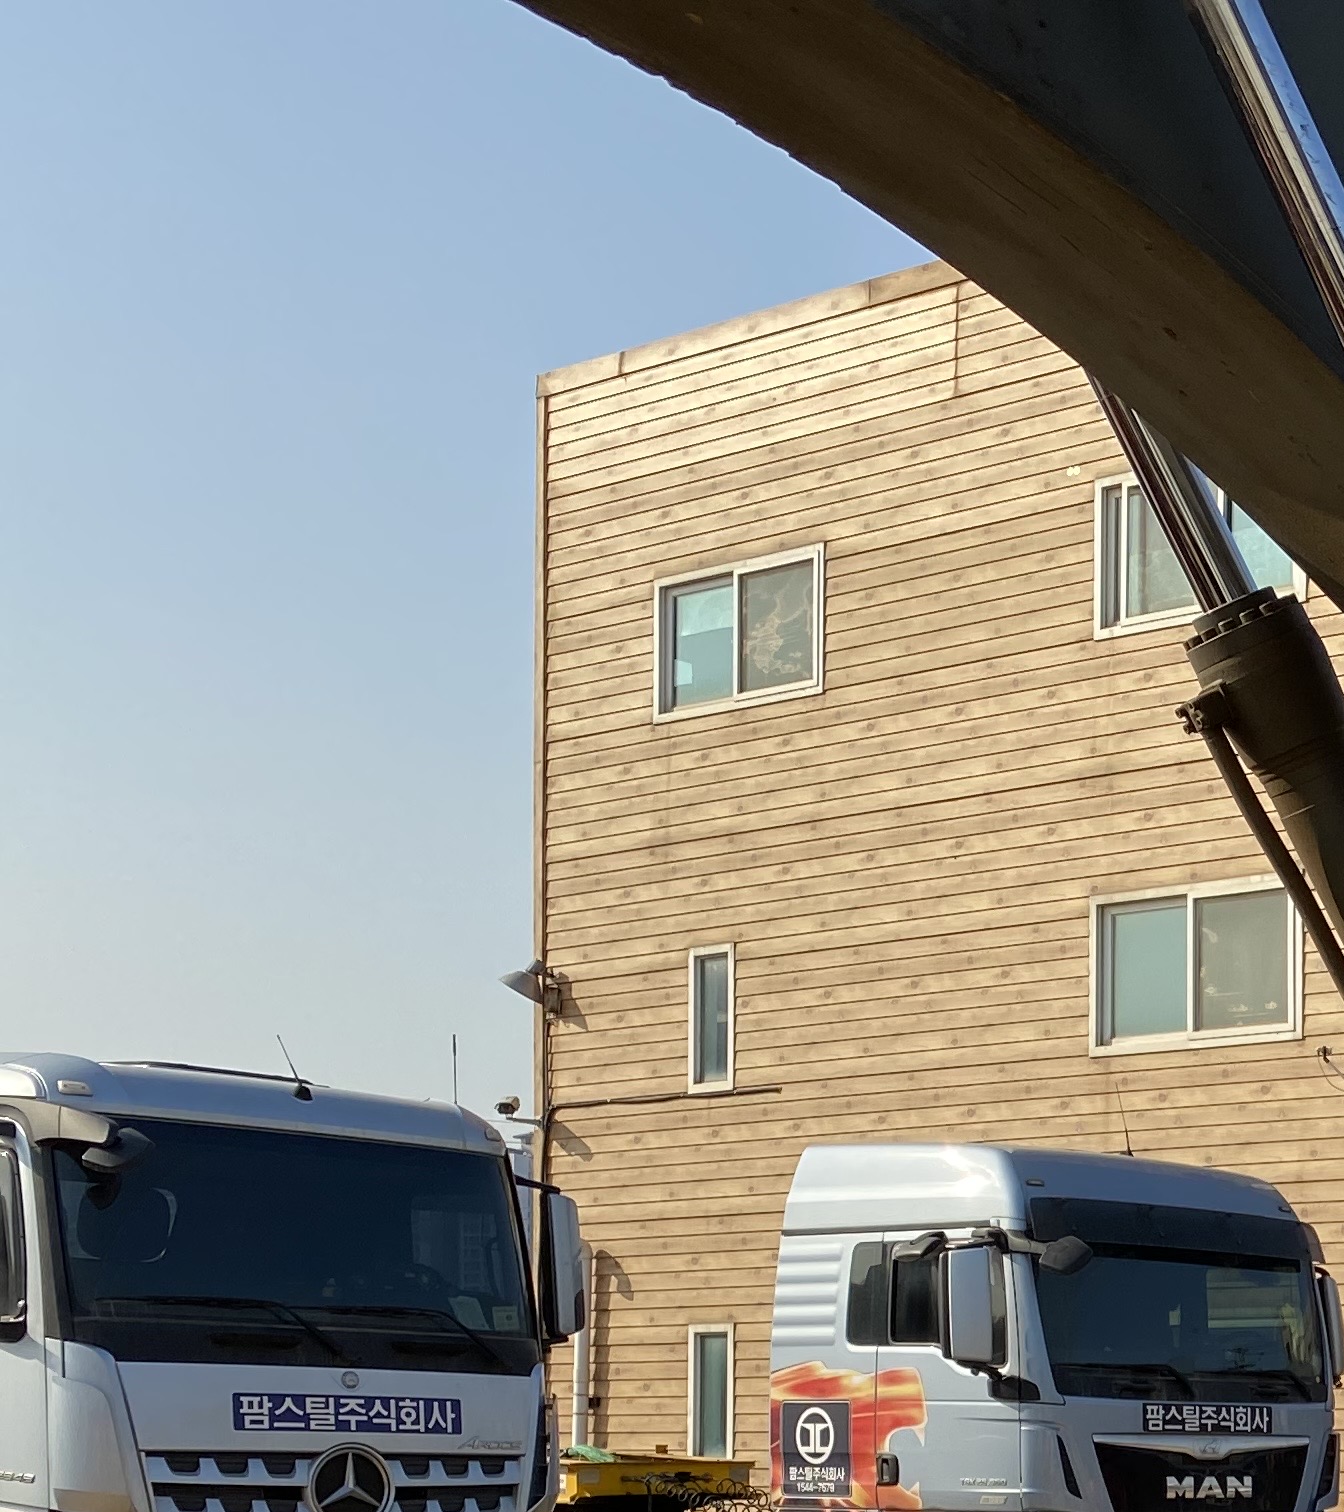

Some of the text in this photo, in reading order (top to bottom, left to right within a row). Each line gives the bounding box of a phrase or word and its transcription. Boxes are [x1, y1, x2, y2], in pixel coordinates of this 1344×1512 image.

[239, 1395, 456, 1434] 팜스틸주식회사
[1146, 1405, 1270, 1433] 팜스틸주식회사
[1166, 1475, 1253, 1499] MAN
